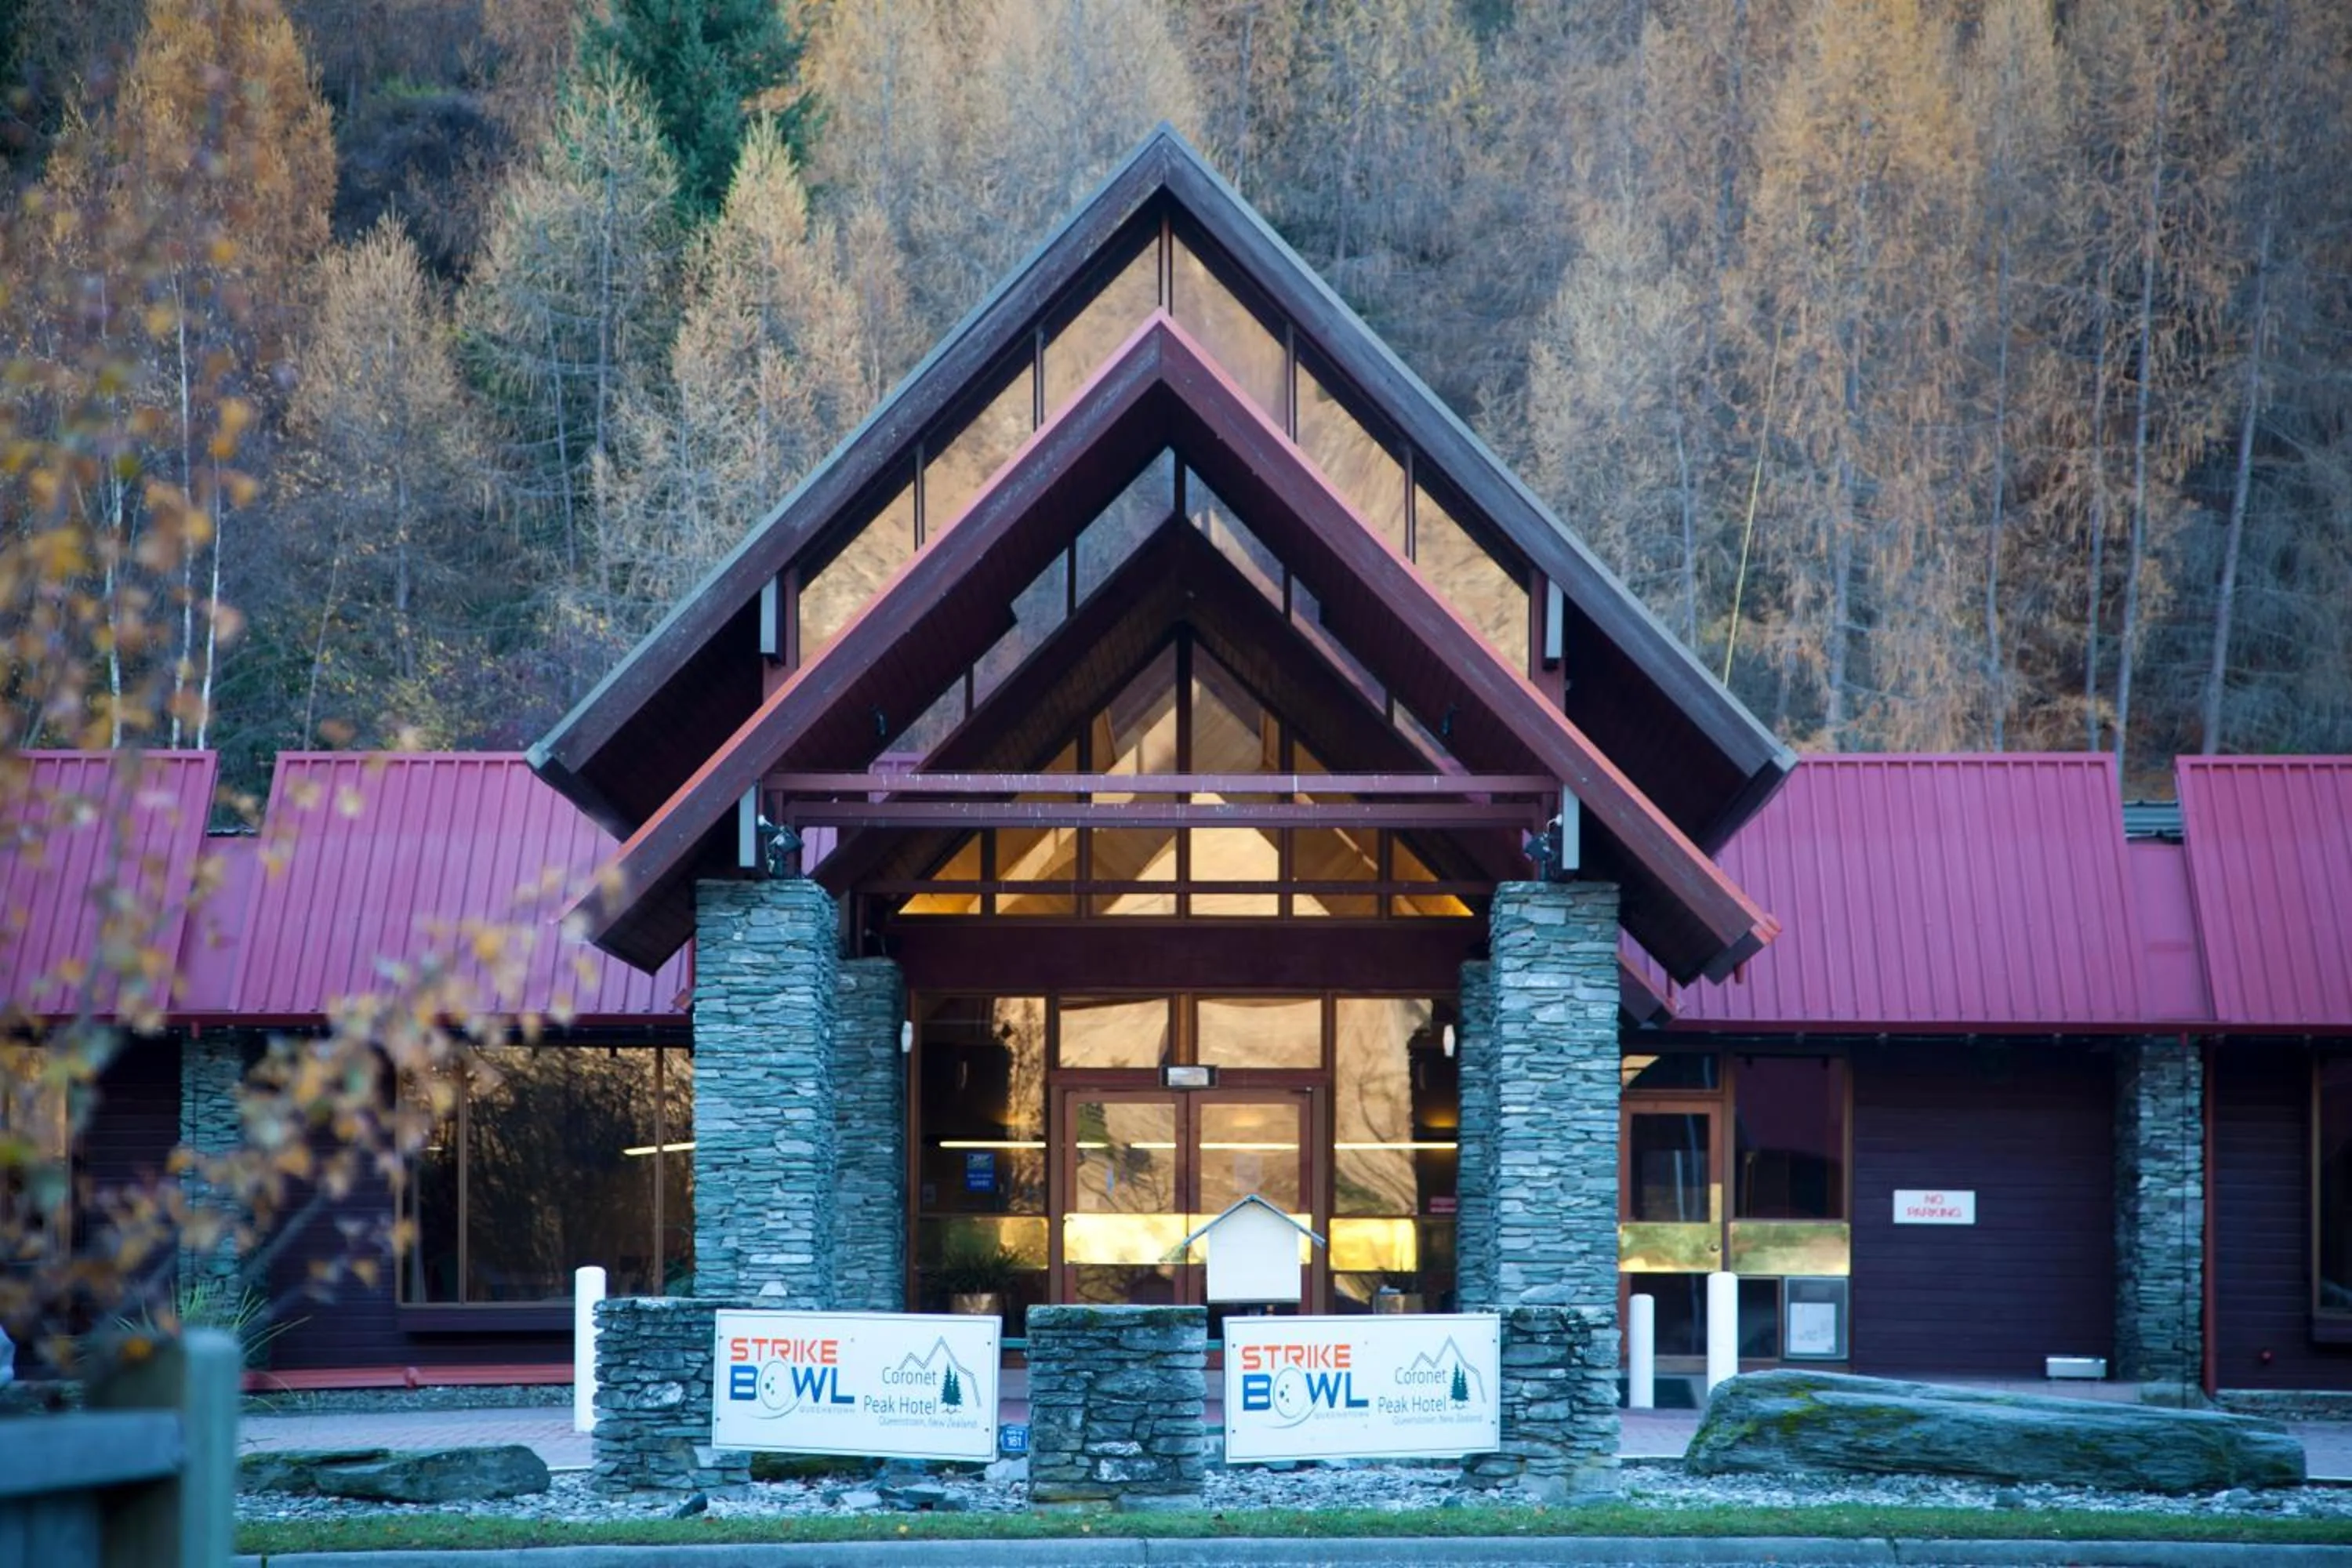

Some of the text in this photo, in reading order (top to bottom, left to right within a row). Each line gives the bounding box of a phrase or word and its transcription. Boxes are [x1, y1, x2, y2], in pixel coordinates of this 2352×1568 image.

[1924, 1193, 1944, 1205] NO
[1907, 1207, 1962, 1218] PARKING
[730, 1338, 838, 1363] STRIKE
[1241, 1344, 1352, 1370] STRIKE
[882, 1367, 938, 1385] Coronet
[1394, 1366, 1447, 1385] Coronet
[729, 1362, 855, 1410] BOWL
[1242, 1367, 1370, 1419] BOWL
[863, 1395, 938, 1414] Peak Hotel
[1377, 1395, 1446, 1414] Peak Hotel
